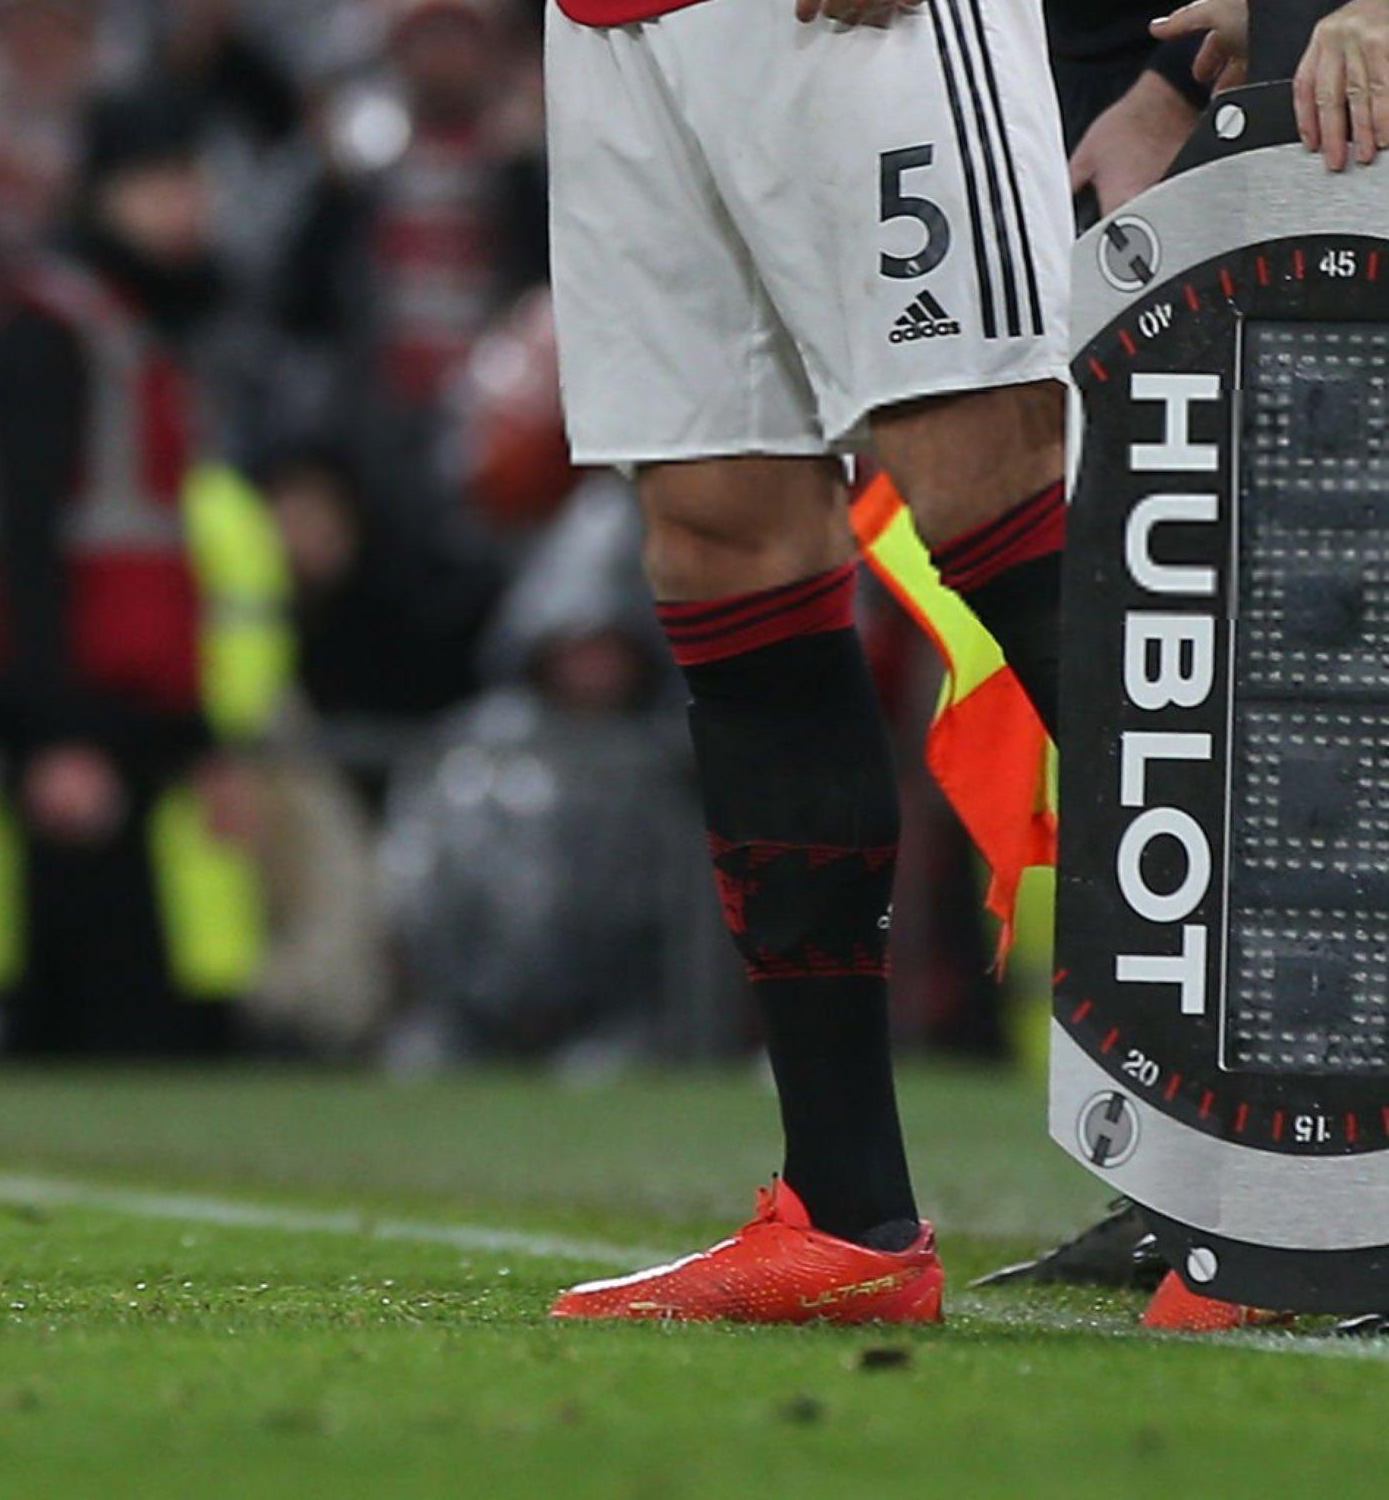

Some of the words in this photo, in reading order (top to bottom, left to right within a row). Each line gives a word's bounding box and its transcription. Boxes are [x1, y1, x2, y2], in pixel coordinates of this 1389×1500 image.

[879, 143, 950, 279] 5
[1319, 249, 1356, 277] 45
[888, 319, 961, 344] adidas
[1115, 372, 1221, 1015] HUBLOT
[1122, 1049, 1160, 1088] 20
[1294, 1115, 1332, 1143] 15
